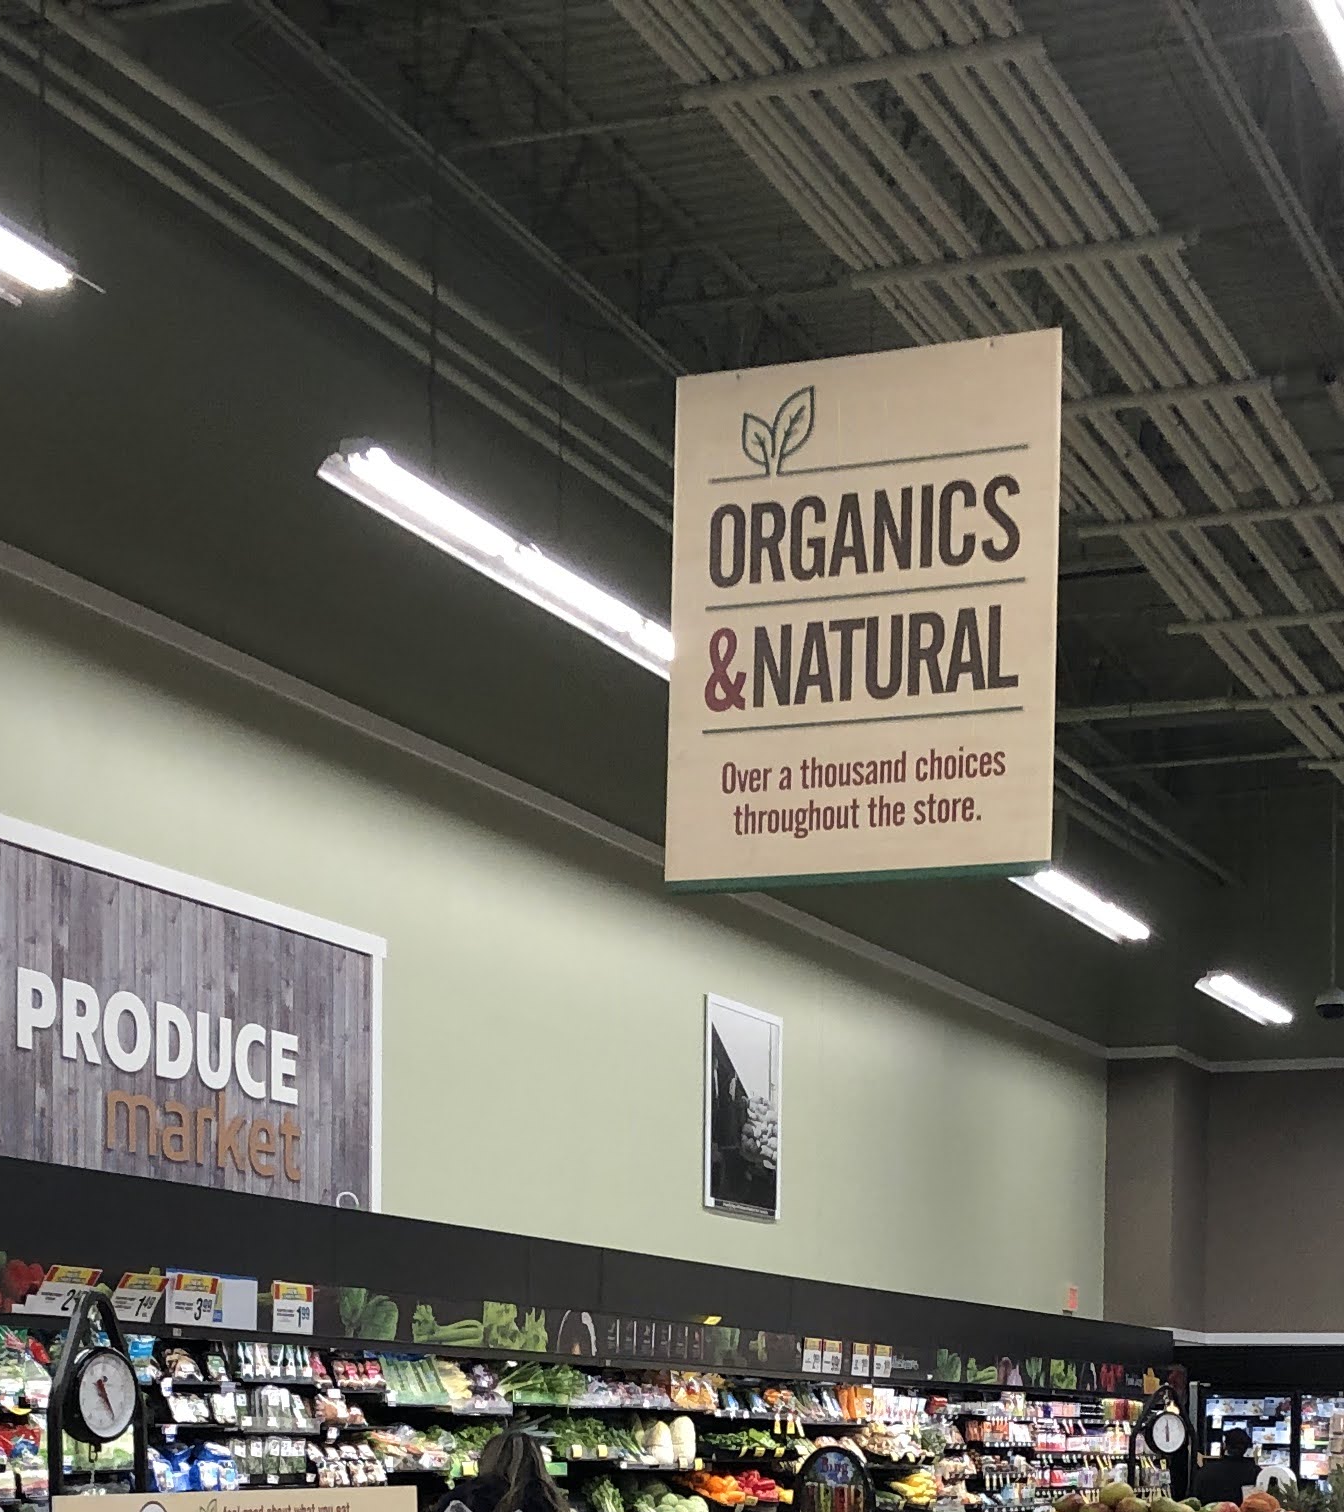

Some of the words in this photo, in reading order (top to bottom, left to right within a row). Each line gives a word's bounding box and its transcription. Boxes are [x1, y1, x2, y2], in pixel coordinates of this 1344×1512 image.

[709, 474, 1021, 588] ORGANICS
[721, 762, 772, 794] Over
[778, 766, 792, 790] a
[800, 752, 907, 788] thousand
[916, 746, 1006, 783] choices
[733, 800, 860, 838] throughout
[868, 796, 906, 828] the
[913, 793, 983, 825] store.
[16, 966, 300, 1107] PRODUCE
[105, 1088, 303, 1183] market
